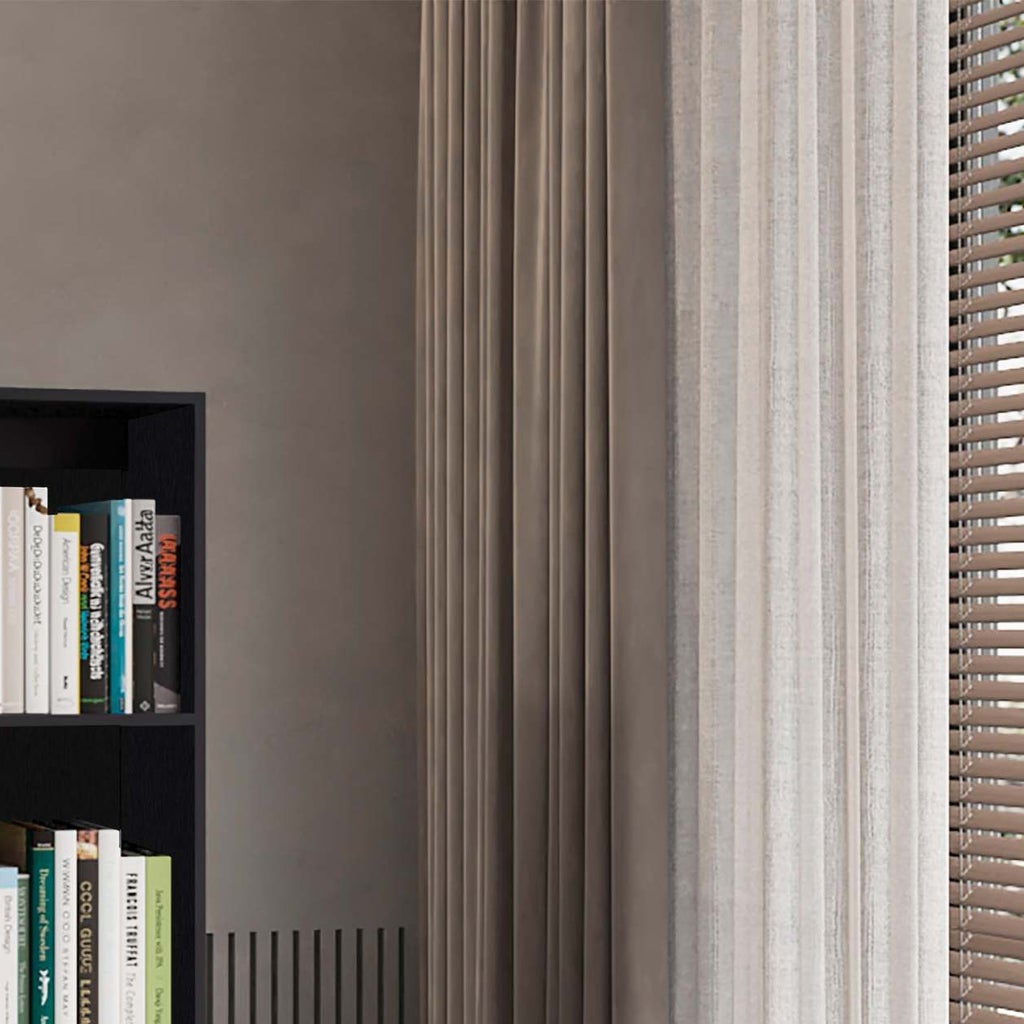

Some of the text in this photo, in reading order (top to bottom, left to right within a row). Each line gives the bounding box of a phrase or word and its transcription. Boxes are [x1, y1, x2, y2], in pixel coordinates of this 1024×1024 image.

[61, 537, 71, 605] American Design
[37, 869, 49, 961] Dreaming of Sweden
[3, 925, 12, 954] Design
[125, 973, 136, 989] The
